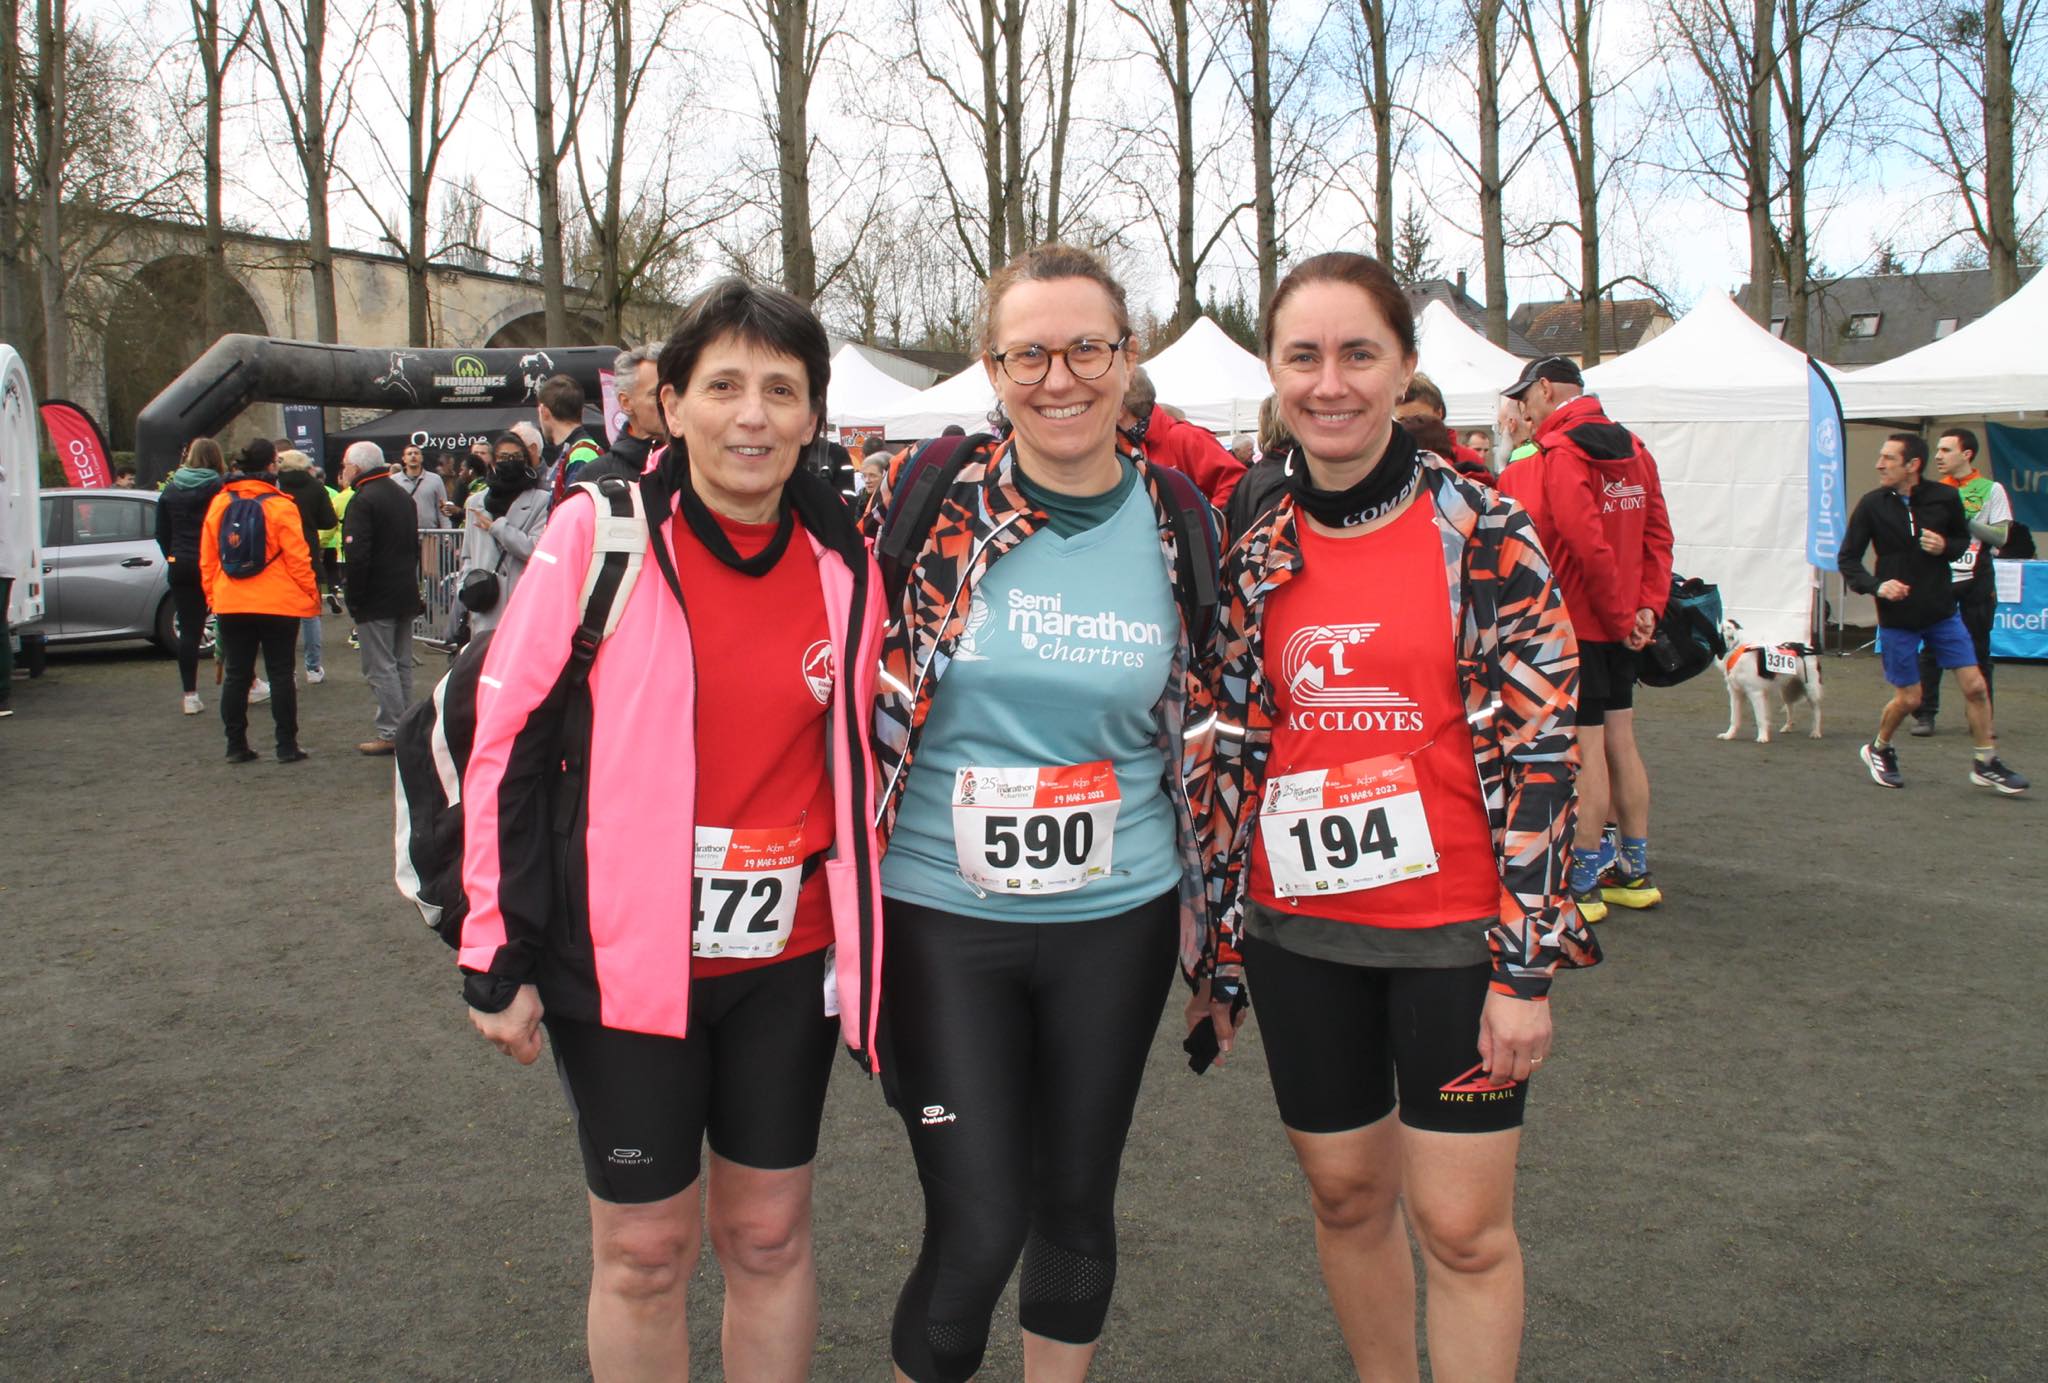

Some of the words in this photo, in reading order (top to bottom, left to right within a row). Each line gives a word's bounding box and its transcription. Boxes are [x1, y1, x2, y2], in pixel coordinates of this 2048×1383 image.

[434, 376, 506, 386] ENDURANCE
[454, 386, 486, 395] SHOP
[411, 431, 488, 450] Oxygène
[1008, 588, 1062, 612] Semi
[1008, 608, 1163, 647] marathon
[1038, 637, 1145, 669] chartres
[1767, 653, 1794, 669] 3316
[1288, 710, 1315, 731] AC
[1318, 710, 1424, 732] CLOYES
[1054, 795, 1064, 804] 19
[1066, 792, 1087, 803] MARS
[1339, 794, 1349, 803] 19
[1351, 789, 1374, 801] MARS
[1375, 784, 1397, 795] 2023
[985, 811, 1094, 870] 590
[1289, 807, 1399, 872] 194
[744, 859, 755, 868] 19
[1440, 1093, 1474, 1102] NIKE
[1481, 1089, 1514, 1102] TRAIL
